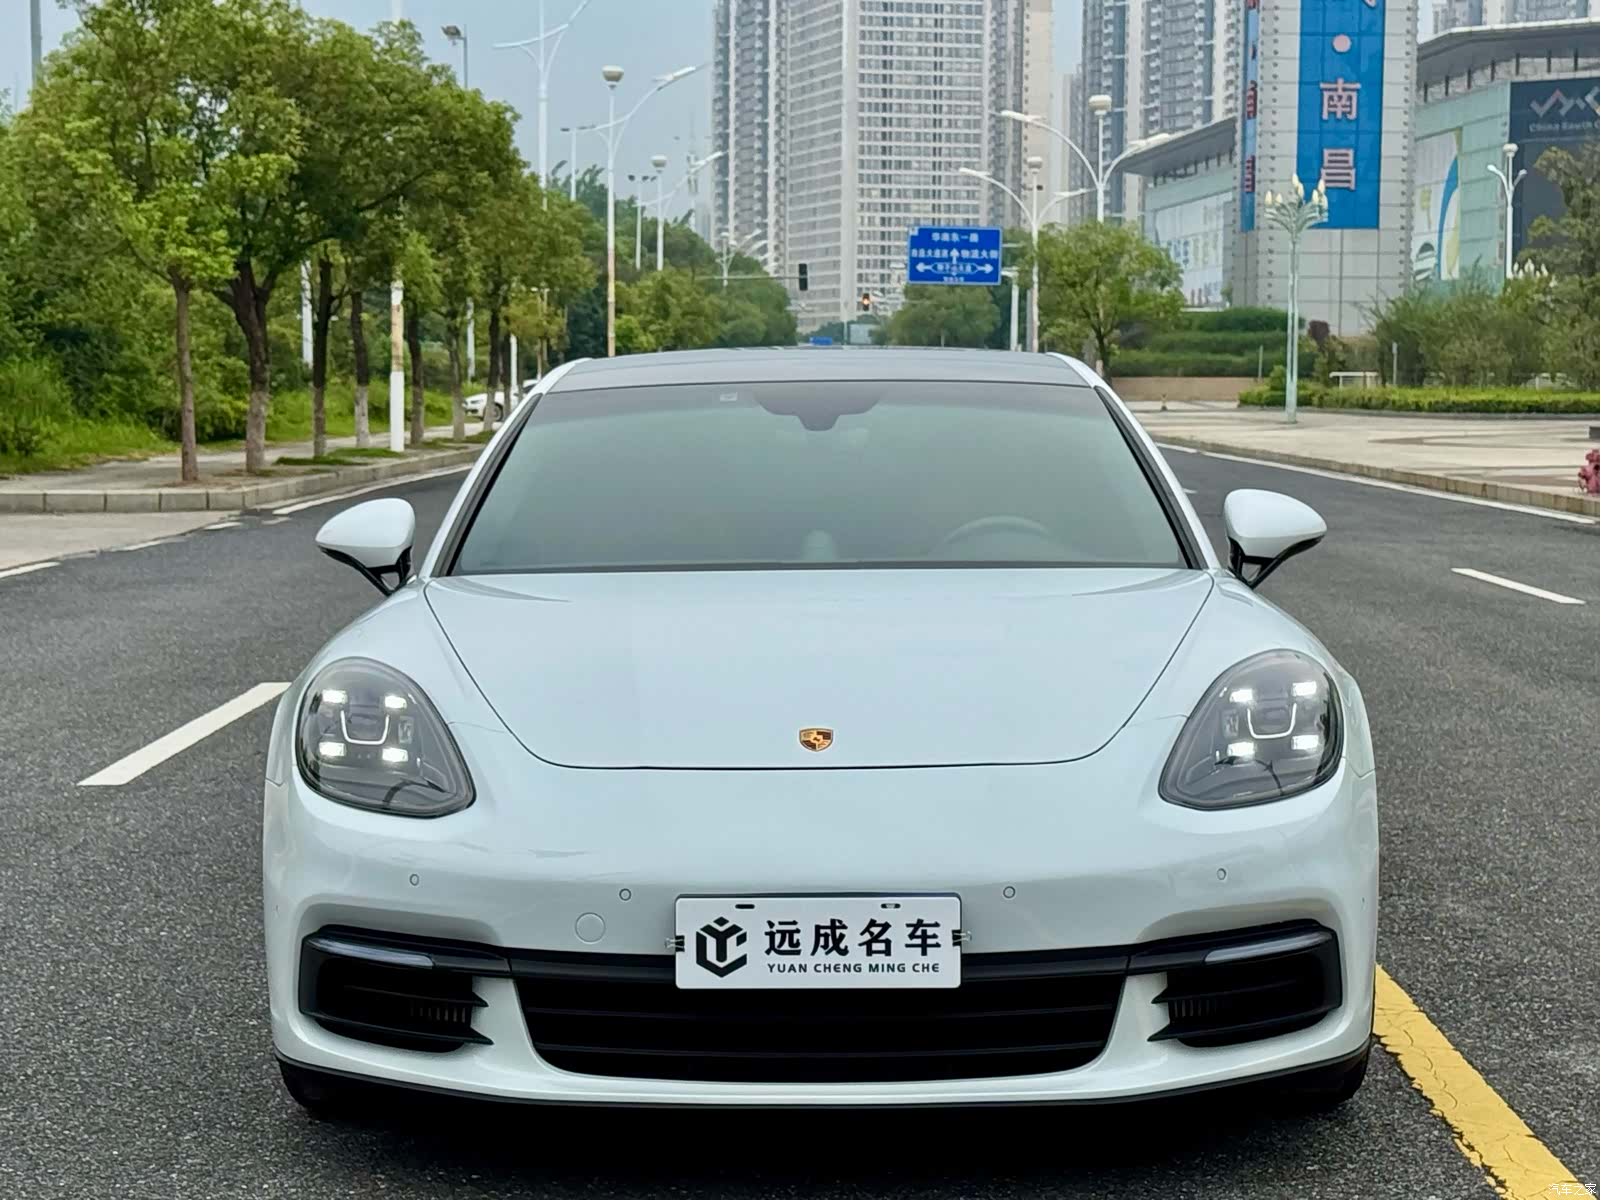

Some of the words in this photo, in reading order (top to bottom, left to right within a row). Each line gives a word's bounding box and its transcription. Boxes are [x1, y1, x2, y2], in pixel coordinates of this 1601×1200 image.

[763, 918, 942, 957] 远成名车
[767, 962, 808, 974] YUAN
[813, 962, 863, 974] CHENG
[868, 962, 907, 974] MING
[911, 962, 940, 974] CHE
